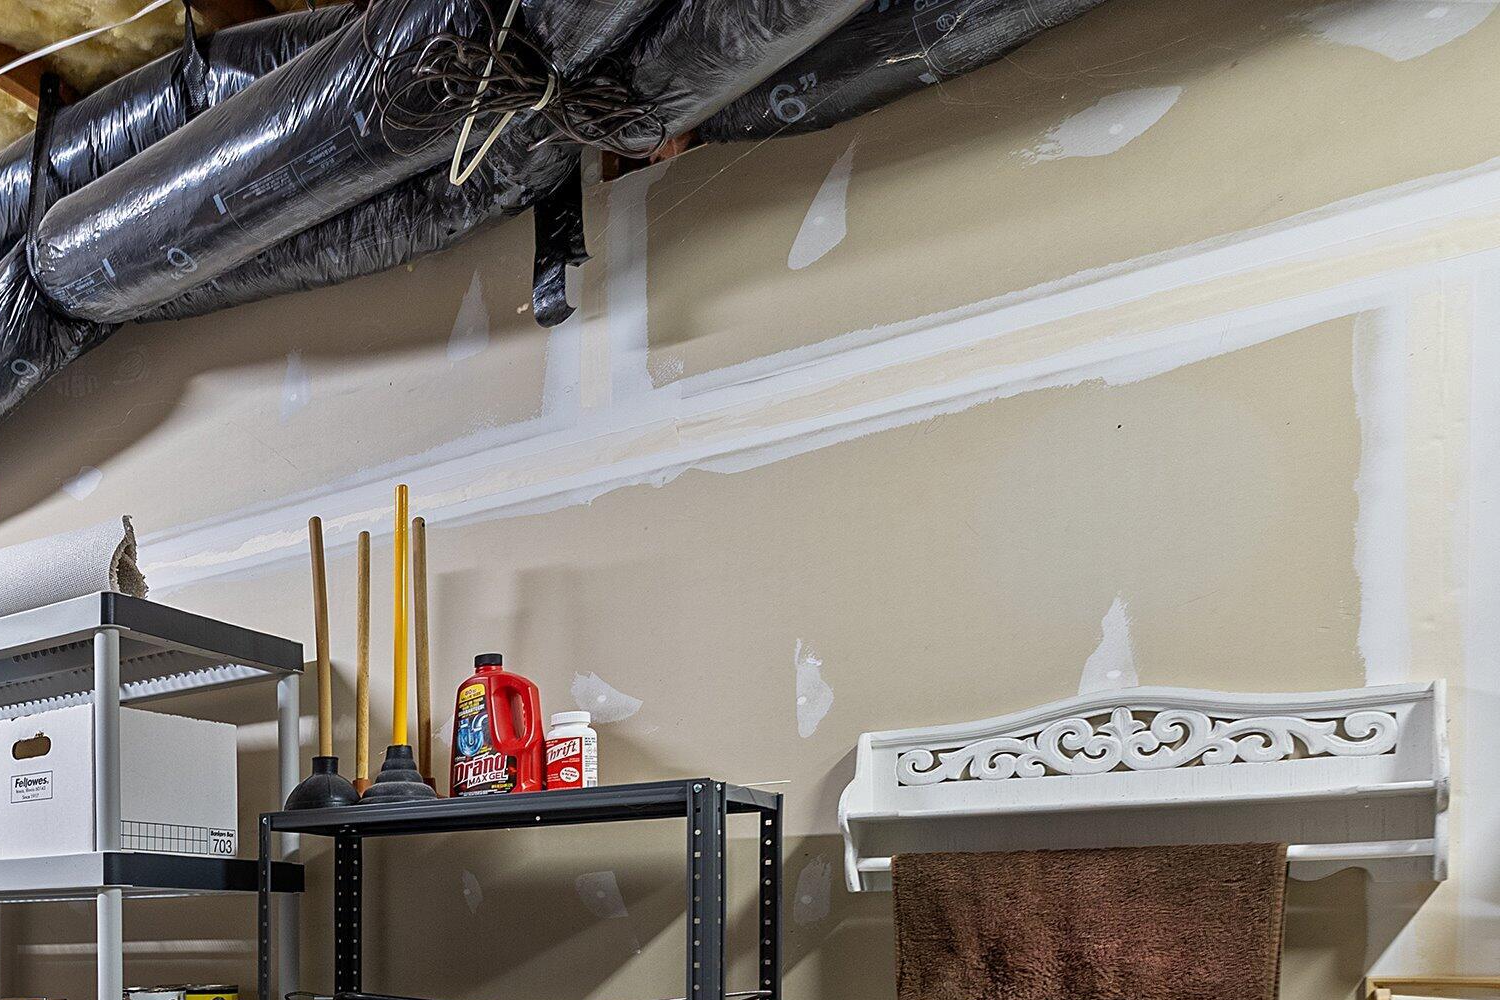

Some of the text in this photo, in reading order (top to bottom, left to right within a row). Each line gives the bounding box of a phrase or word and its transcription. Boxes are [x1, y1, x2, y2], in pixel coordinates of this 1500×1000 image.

[468, 774, 488, 786] MAX
[489, 771, 507, 780] GEL
[213, 839, 232, 853] 703
